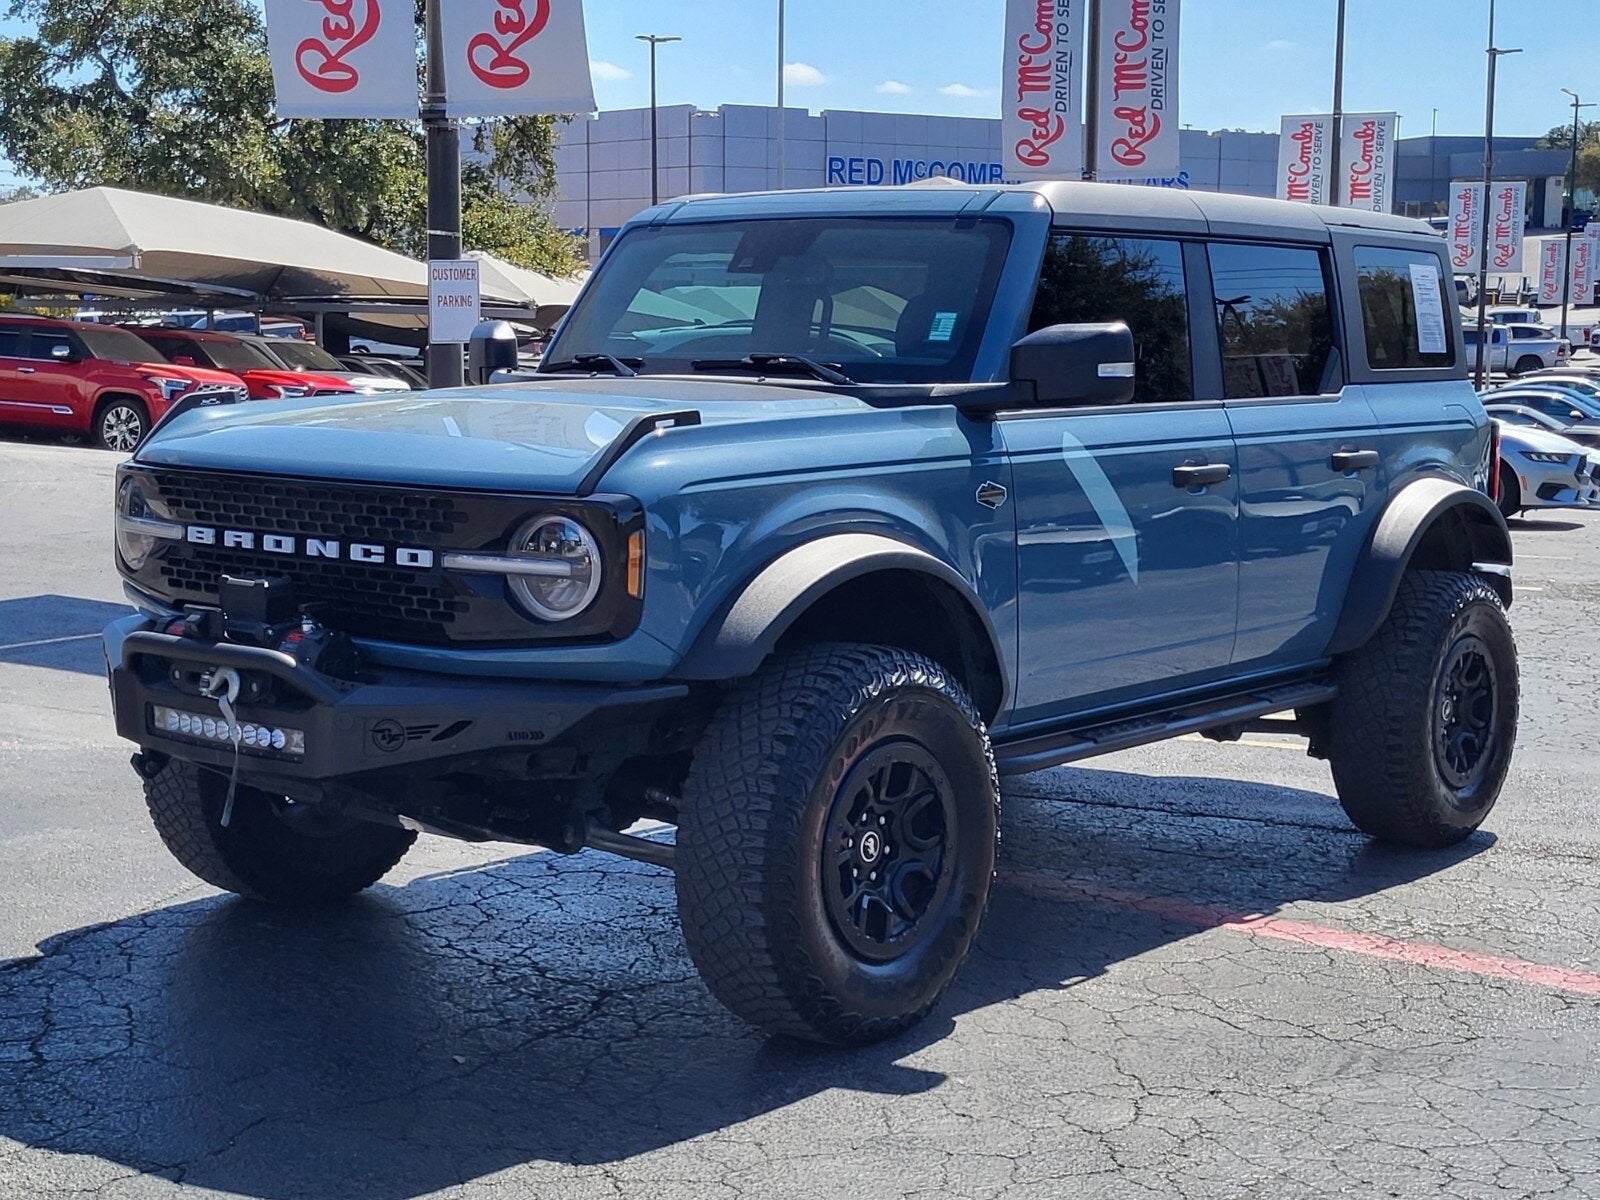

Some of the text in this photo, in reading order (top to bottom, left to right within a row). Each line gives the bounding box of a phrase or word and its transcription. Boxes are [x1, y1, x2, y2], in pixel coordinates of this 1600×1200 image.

[466, 0, 550, 89] Re
[1056, 22, 1069, 45] TO
[1152, 20, 1165, 42] TO
[1055, 50, 1069, 112] DRIVEN
[1151, 47, 1164, 110] DRIVEN
[1015, 107, 1064, 167] Red
[1111, 106, 1160, 166] Red
[1286, 122, 1314, 201] McCombs
[1310, 121, 1324, 205] RIVEN TO SERVE
[1349, 120, 1376, 205] McCombs
[1372, 120, 1386, 212] DRIVEN TO SERVE
[828, 156, 1004, 185] RED McCOMB
[1452, 188, 1474, 267] Red McCombs
[1493, 188, 1515, 268] Red McCombs
[432, 268, 477, 281] CUSTOMER
[437, 295, 473, 307] PARKING
[187, 525, 433, 568] BRONCO
